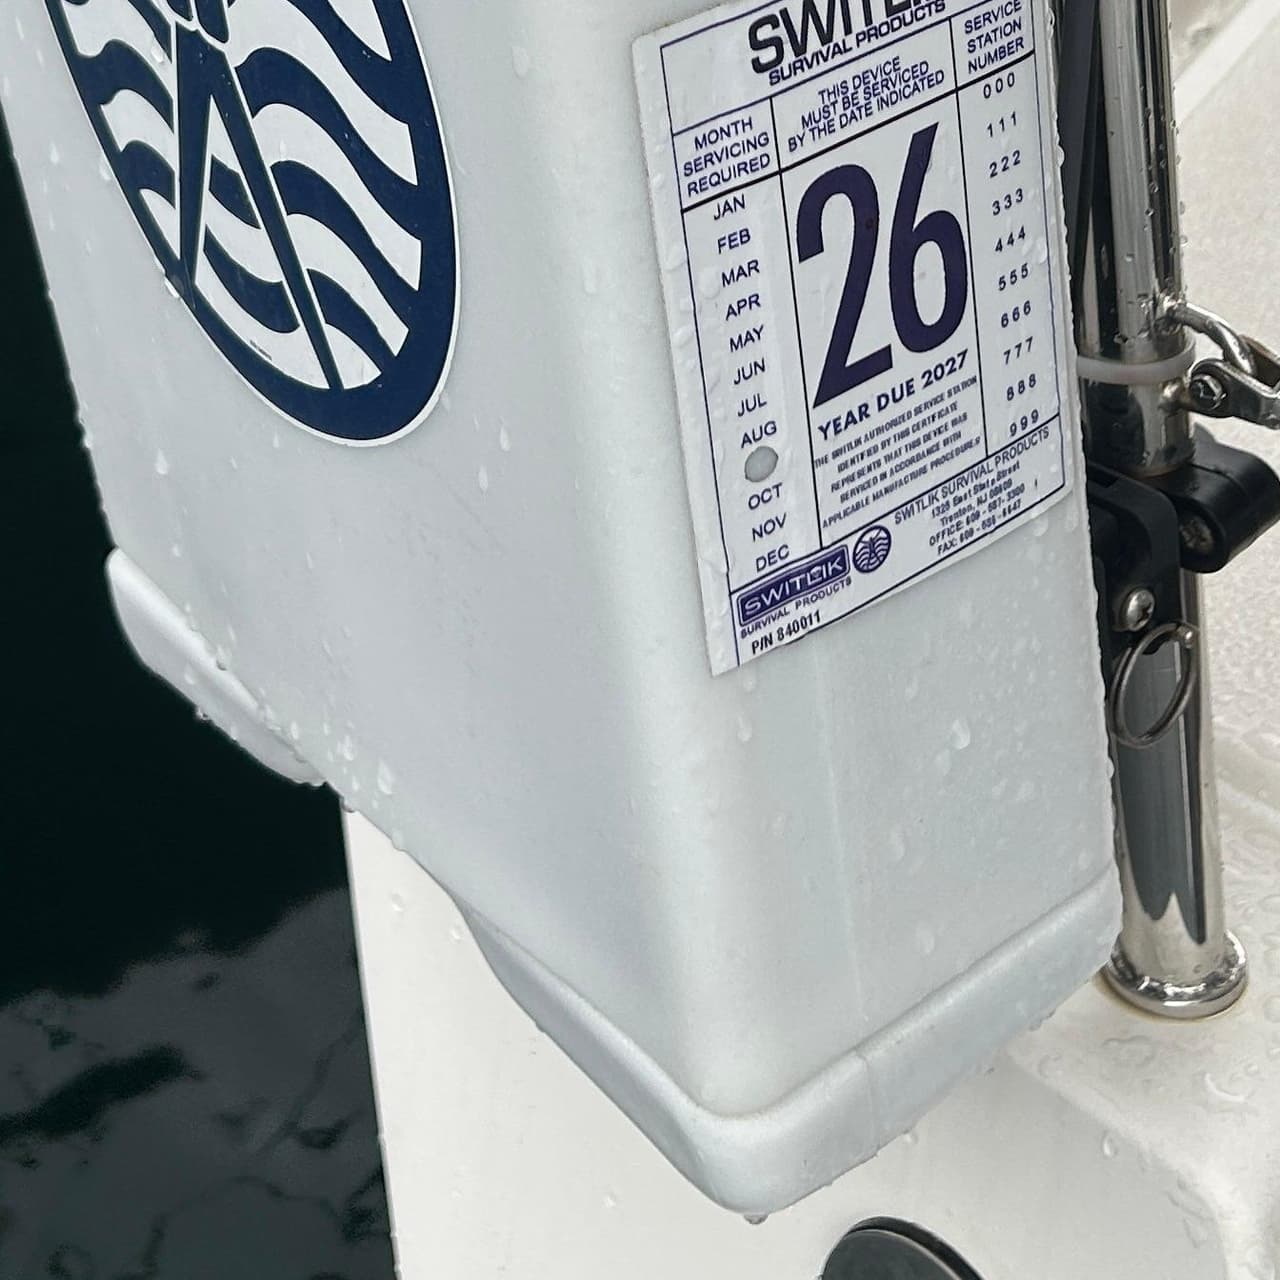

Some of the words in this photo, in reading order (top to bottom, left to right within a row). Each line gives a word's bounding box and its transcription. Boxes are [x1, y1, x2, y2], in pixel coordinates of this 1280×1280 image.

[967, 16, 1022, 54] STATION
[766, 38, 853, 86] SURVIVAL
[968, 36, 1024, 74] NUMBER
[801, 98, 838, 130] MUST
[842, 89, 860, 112] BE
[863, 60, 929, 101] SERVICED
[818, 80, 849, 105] THIS
[852, 55, 901, 91] DEVICE
[788, 131, 805, 153] BY
[808, 117, 836, 142] THE
[839, 100, 873, 129] DATE
[876, 69, 945, 112] INDICATED
[694, 116, 753, 151] MONTH
[683, 131, 769, 177] SERVICING
[687, 153, 770, 198] REQUIRED
[713, 193, 745, 221] JAN
[717, 228, 751, 255] FEB
[721, 259, 760, 288] MAR
[796, 121, 968, 409] 26
[725, 293, 761, 321] APR
[730, 324, 764, 353] MAY
[734, 357, 765, 385] JUN
[737, 393, 767, 417] JUL
[817, 402, 871, 441] YEAR
[877, 377, 915, 413] DUE
[921, 348, 968, 389] 2027
[863, 410, 912, 443] AUTHORIZED
[913, 392, 945, 417] SERVICE
[947, 375, 977, 398] STATION
[741, 420, 777, 449] AUG
[880, 437, 891, 450] BY
[893, 427, 910, 443] THIS
[911, 400, 958, 434] CERTIFICATE
[831, 458, 882, 493] REPRESENTS
[883, 446, 902, 464] THAT
[904, 437, 922, 453] THIS
[922, 422, 949, 444] DEVICE
[951, 412, 968, 428] WAS
[840, 476, 878, 504] SERVICED
[879, 471, 887, 482] IN
[889, 441, 940, 478] ACCORDANCE
[942, 430, 961, 447] WITH
[996, 460, 1020, 482] Street
[822, 496, 870, 529] APPLICABLE
[930, 436, 981, 470] PROCEDURES
[893, 487, 940, 525] SWITLIK
[939, 456, 994, 499] SURVIVAL
[994, 422, 1050, 468] PRODUCTS
[748, 482, 783, 511] OCT
[977, 492, 988, 507] NJ
[752, 513, 786, 542] NOV
[937, 537, 958, 556] FAX:
[756, 544, 789, 573] DEC
[745, 557, 843, 615] SWITLIK
[740, 604, 790, 639] SURVIVAL
[795, 575, 852, 610] PRODUCTS
[751, 632, 773, 655] P/N
